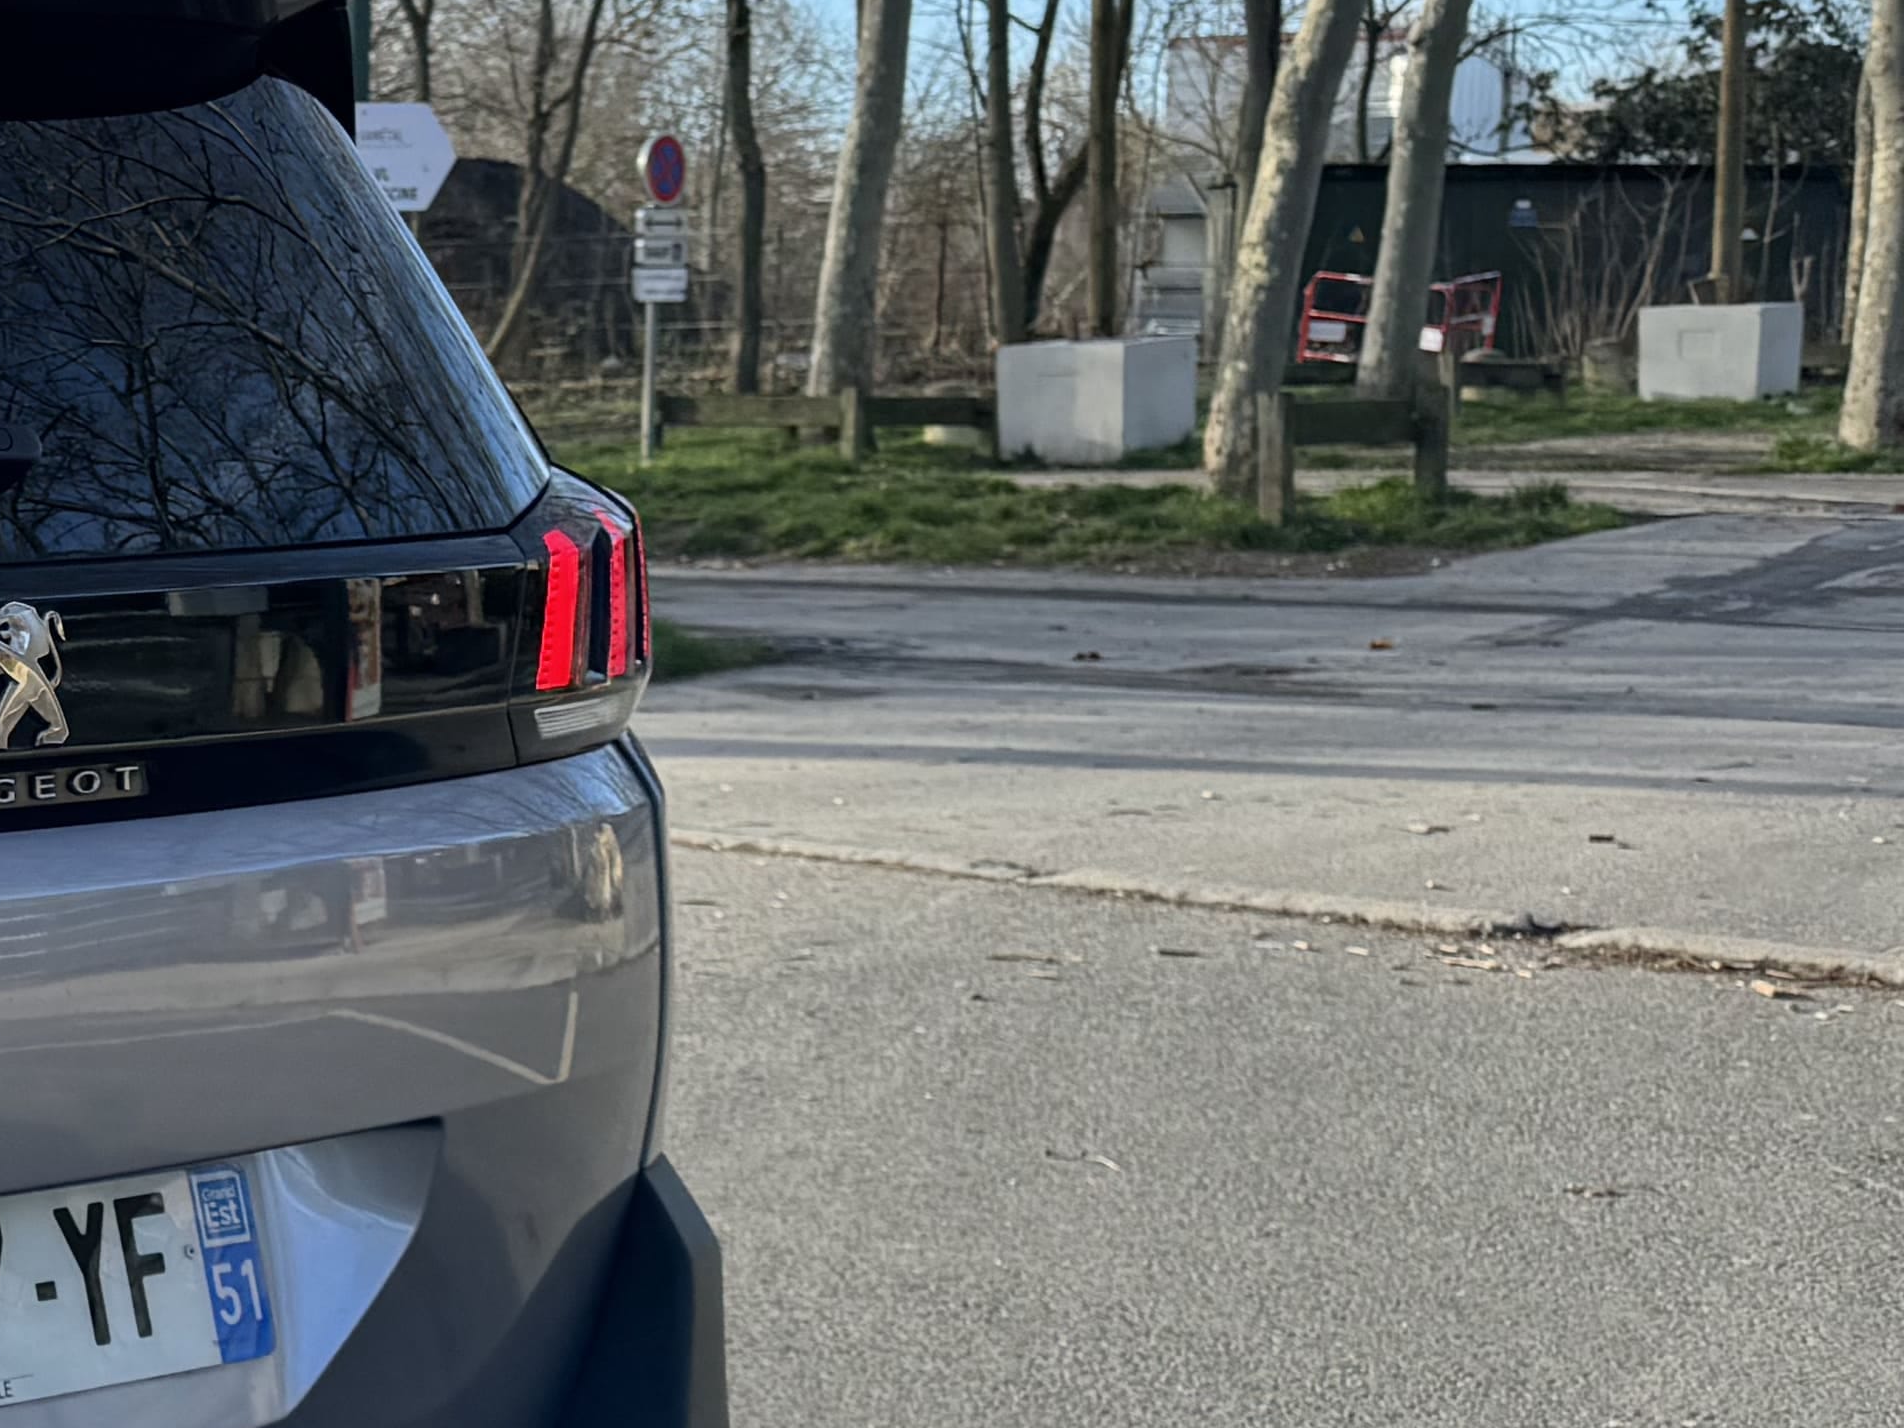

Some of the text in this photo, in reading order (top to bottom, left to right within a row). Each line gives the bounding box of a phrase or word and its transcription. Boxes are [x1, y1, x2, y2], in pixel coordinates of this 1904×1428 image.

[201, 1184, 236, 1202] Grand
[204, 1198, 241, 1229] Est
[212, 1258, 263, 1325] 51
